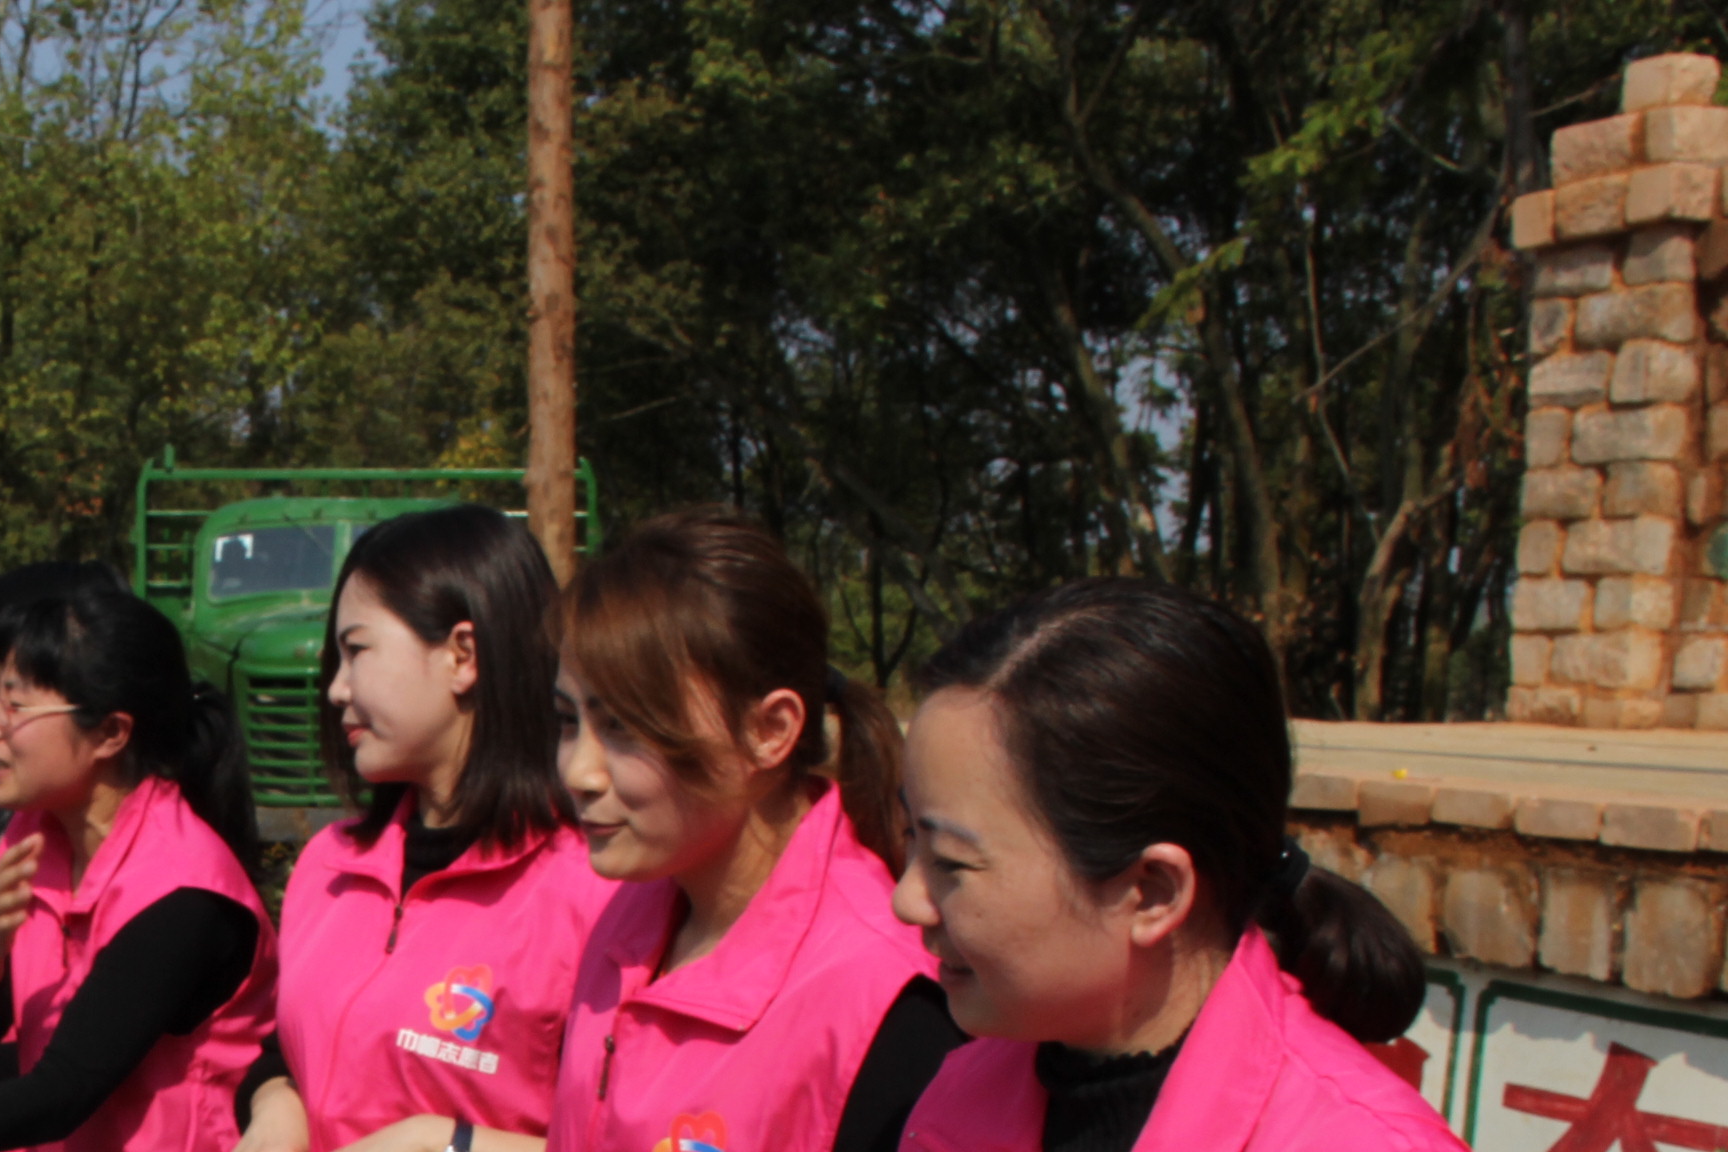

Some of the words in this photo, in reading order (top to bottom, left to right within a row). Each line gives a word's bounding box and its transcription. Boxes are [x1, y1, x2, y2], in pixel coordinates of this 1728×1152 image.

[396, 1028, 499, 1075] 巾帼志愿者
